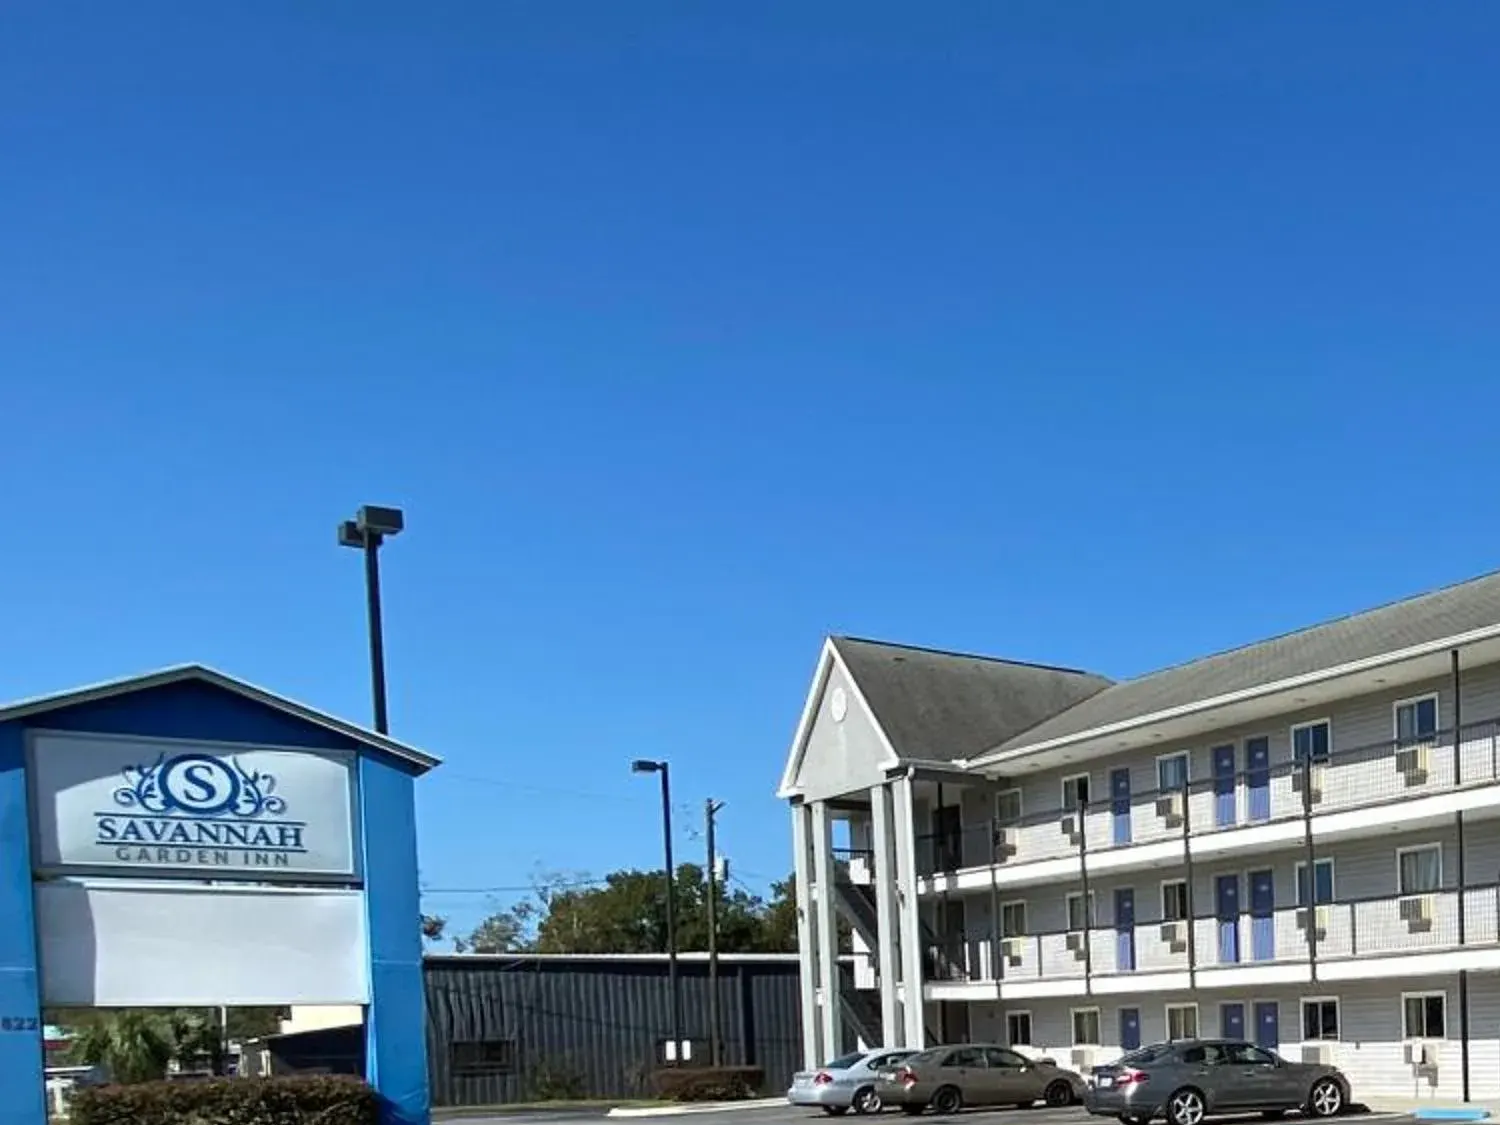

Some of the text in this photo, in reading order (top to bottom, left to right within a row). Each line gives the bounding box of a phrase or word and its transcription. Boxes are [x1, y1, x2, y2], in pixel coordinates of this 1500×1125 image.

[183, 765, 217, 802] S
[98, 818, 305, 848] SAVANNAH
[115, 847, 290, 867] GARDEN INN
